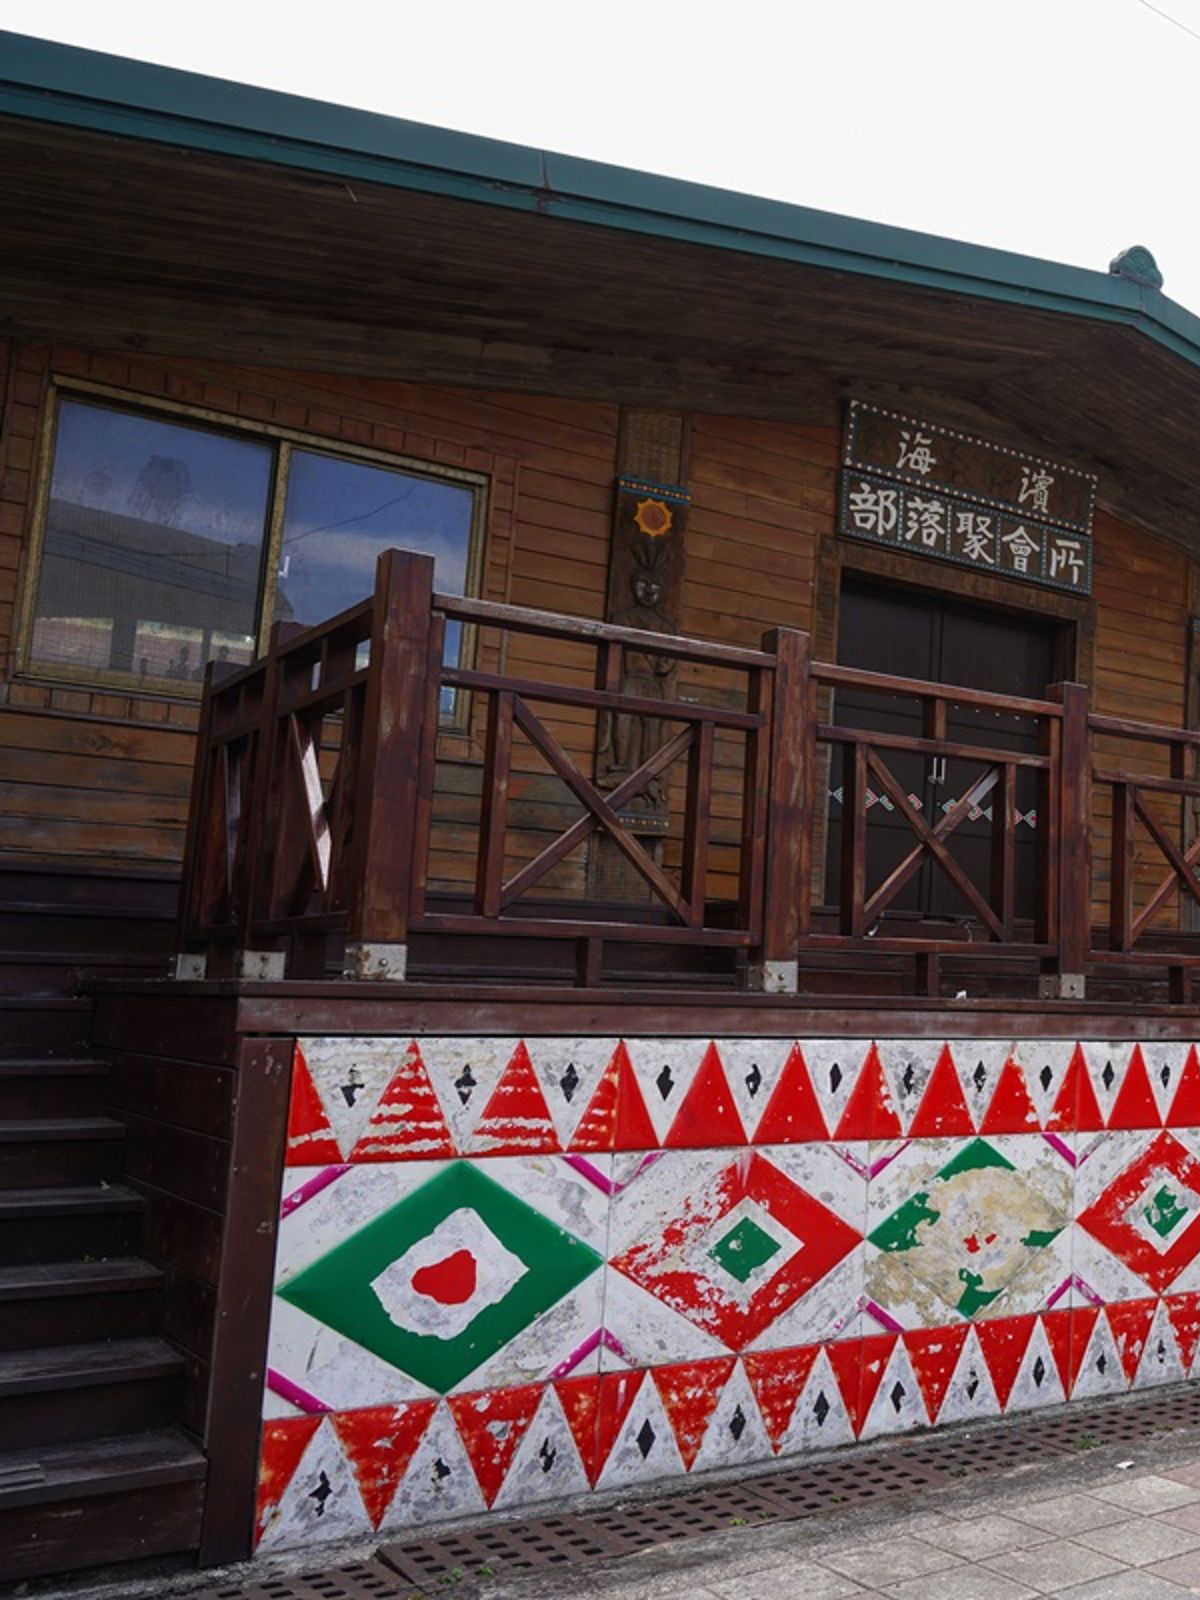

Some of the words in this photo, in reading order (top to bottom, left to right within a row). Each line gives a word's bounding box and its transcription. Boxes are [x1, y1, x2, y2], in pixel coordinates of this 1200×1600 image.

[896, 431, 1054, 513] 海濱
[849, 482, 1084, 584] 部落聚會所
